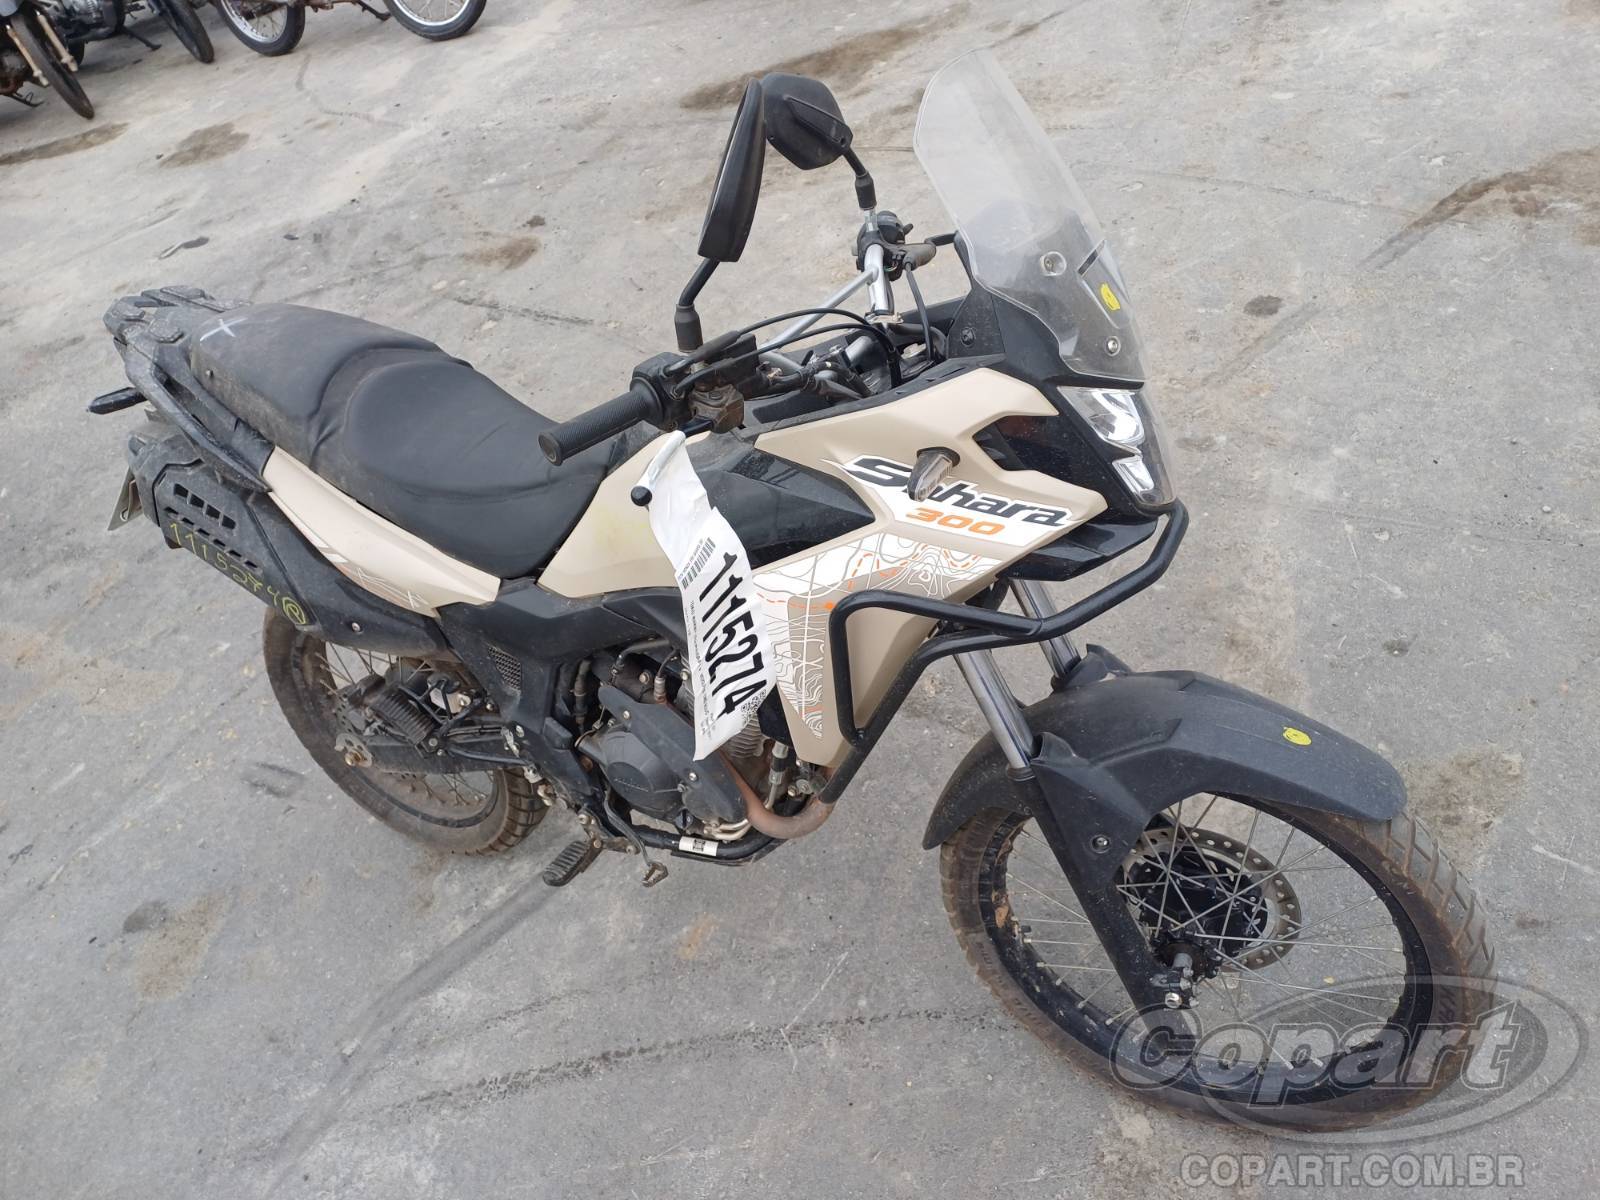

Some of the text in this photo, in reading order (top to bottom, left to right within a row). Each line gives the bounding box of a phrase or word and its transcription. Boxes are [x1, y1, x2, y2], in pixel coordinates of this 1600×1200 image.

[846, 458, 1065, 527] Shara
[906, 507, 1006, 536] 300
[699, 551, 767, 718] 1115274
